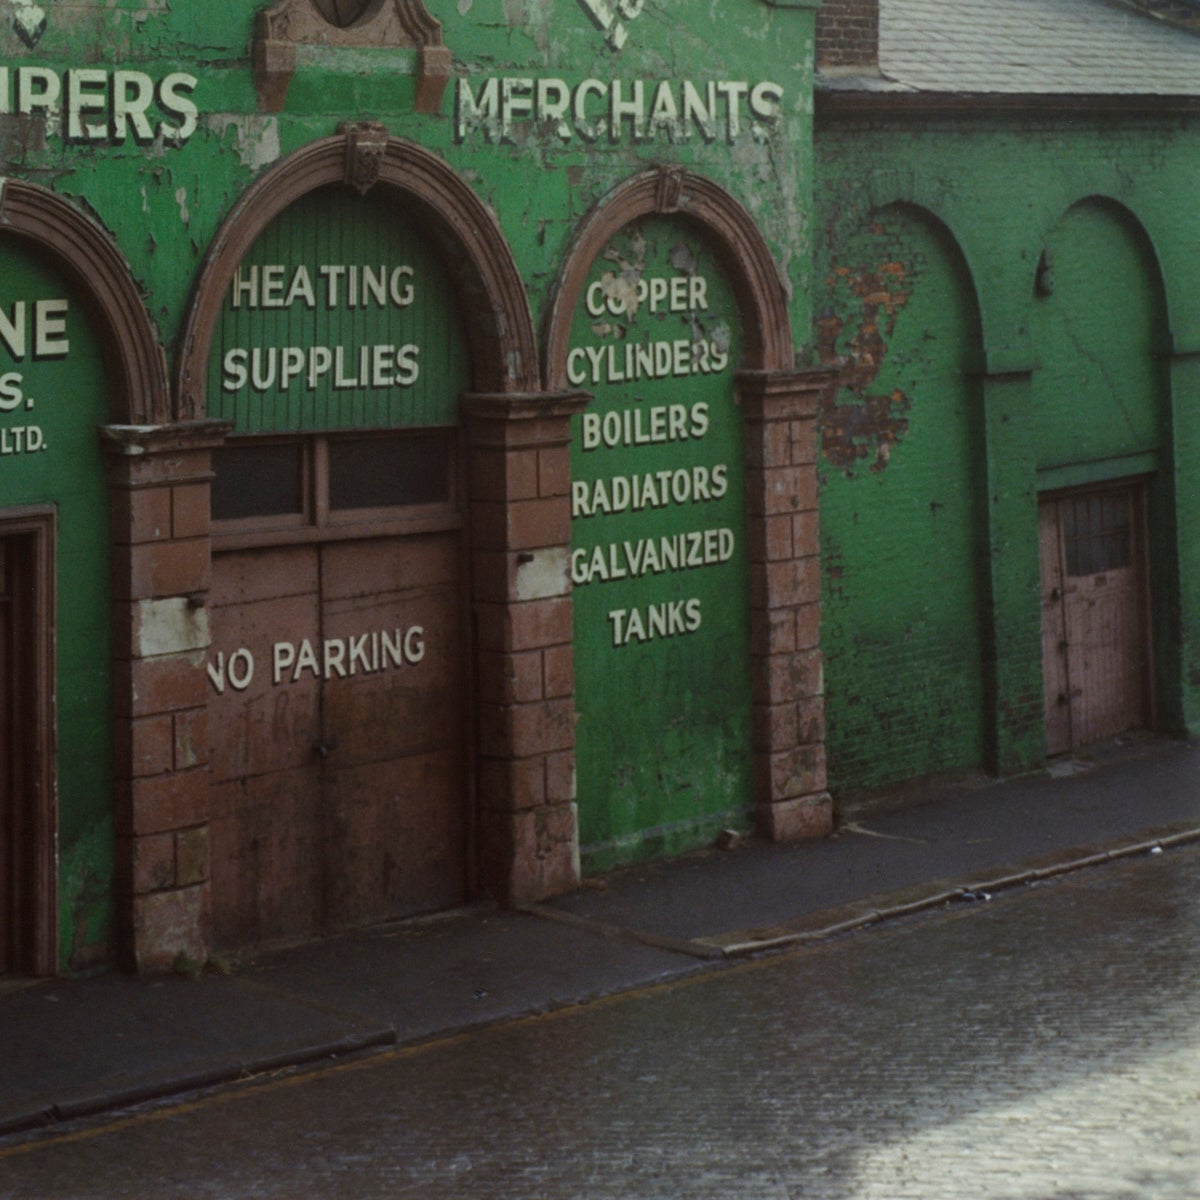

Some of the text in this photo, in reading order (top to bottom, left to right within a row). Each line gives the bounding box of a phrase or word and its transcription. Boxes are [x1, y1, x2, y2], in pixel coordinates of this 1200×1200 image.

[457, 77, 785, 139] MERCHANTS
[233, 264, 415, 308] HEATING
[223, 344, 420, 391] SUPPLIES
[566, 339, 728, 385] CYLINDERS
[0, 425, 48, 454] LTD.
[583, 402, 710, 449] BOILERS
[572, 464, 728, 517] RADIATORS
[570, 528, 735, 584] GALVANIZED
[609, 598, 702, 646] TANKS
[207, 625, 426, 693] NO PARKING
